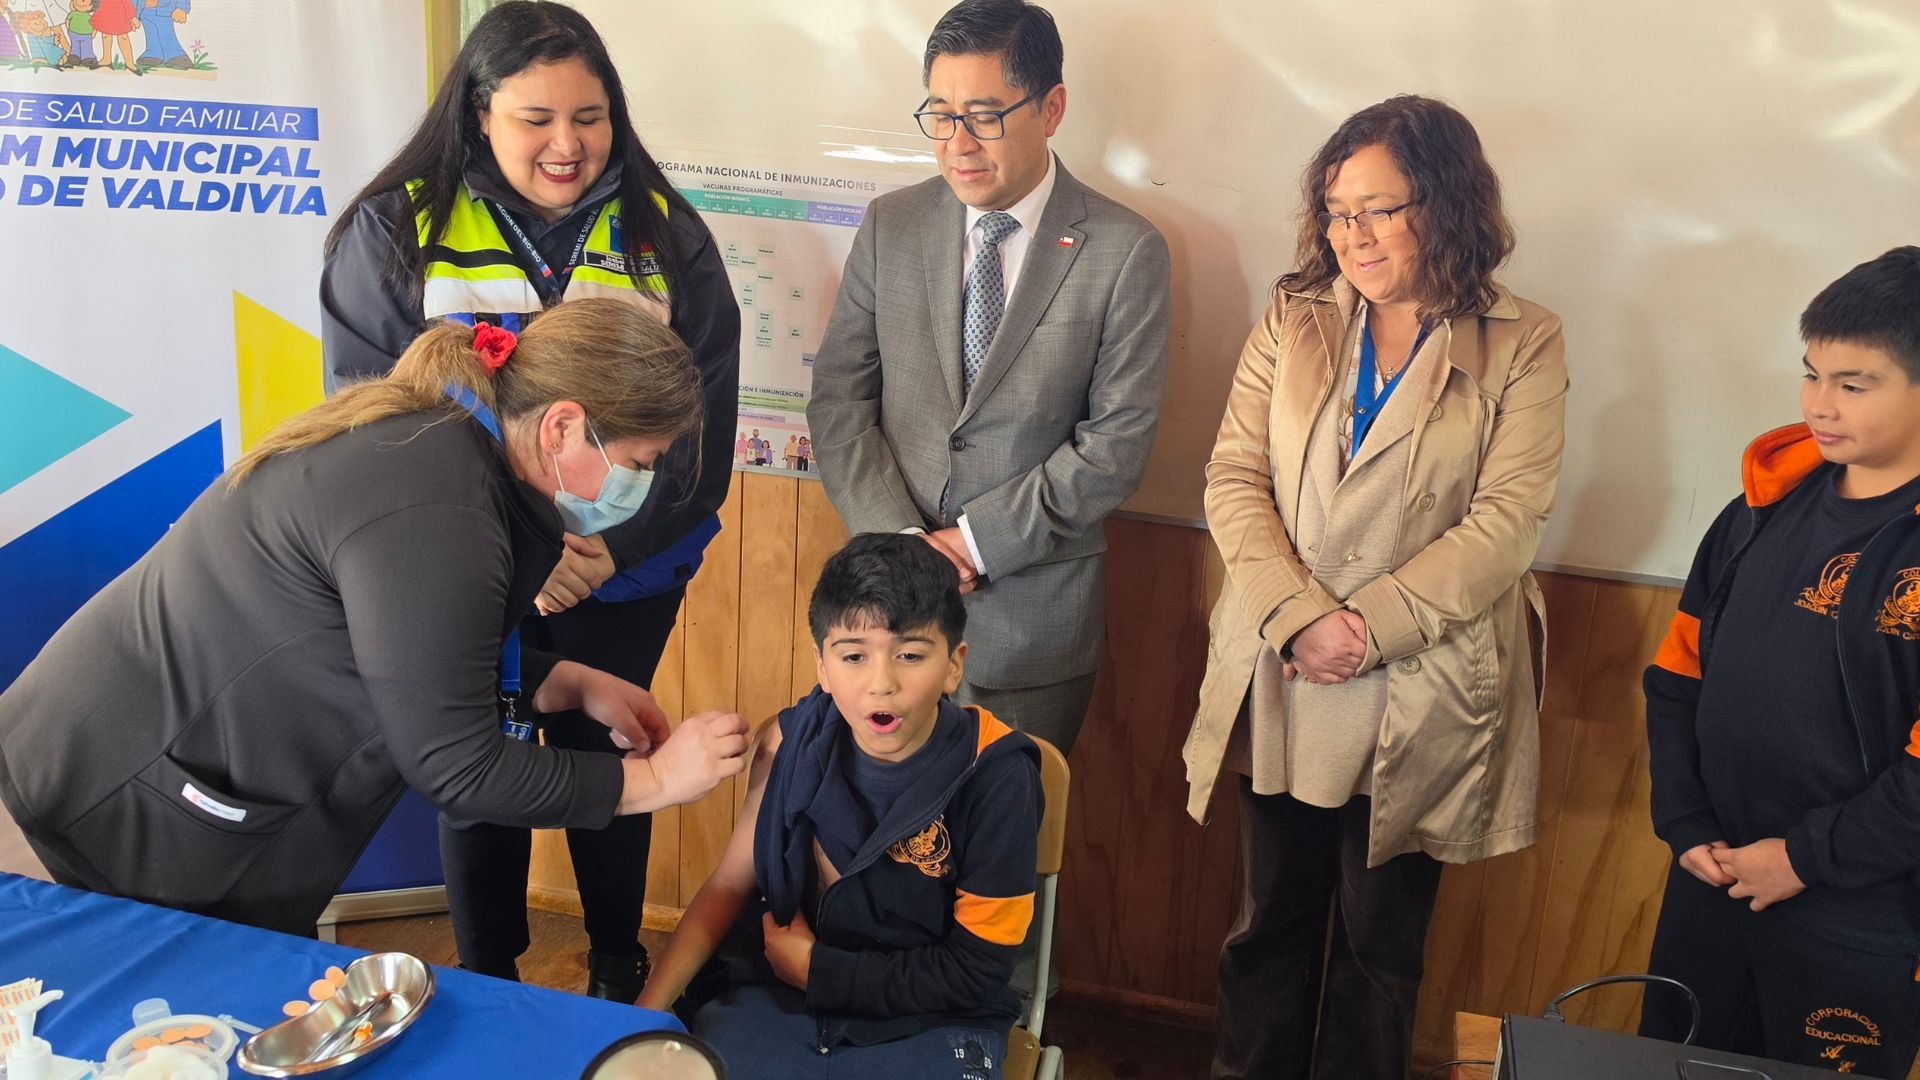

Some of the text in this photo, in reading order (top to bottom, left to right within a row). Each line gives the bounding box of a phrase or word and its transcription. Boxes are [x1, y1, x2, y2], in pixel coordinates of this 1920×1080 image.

[44, 100, 149, 125] SALUD
[159, 105, 301, 133] FAMILIAR
[51, 135, 321, 179] MUNICIPAL
[705, 166, 762, 180] NACIONAL
[764, 171, 778, 182] DE
[781, 173, 877, 191] INMUNIZACIONES
[17, 174, 89, 208] DE
[102, 176, 328, 216] VALDIVIA
[702, 182, 783, 196] VACUNAS PROGRAMÁTICAS
[577, 233, 586, 244] DE
[759, 388, 804, 398] INMUNIZACIÓN
[1804, 1026, 1882, 1046] EDUCACIONAL
[954, 1048, 965, 1059] 19
